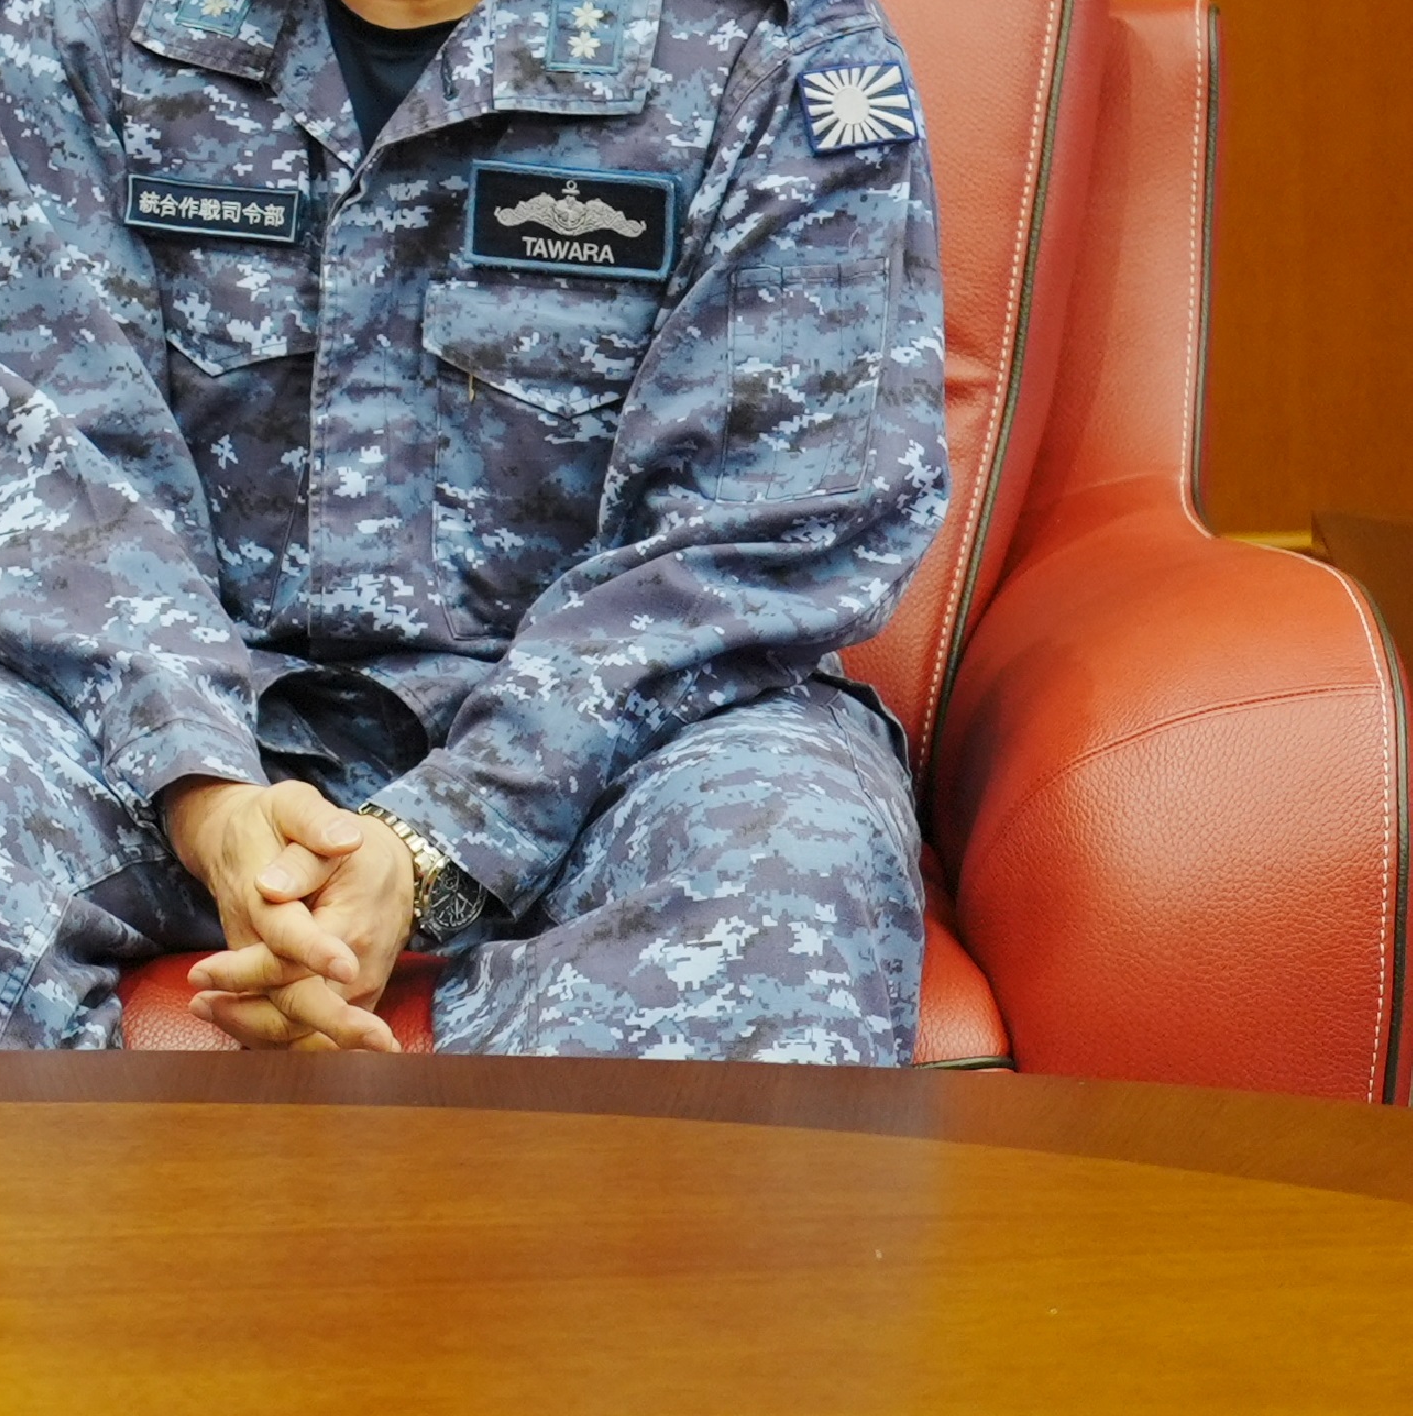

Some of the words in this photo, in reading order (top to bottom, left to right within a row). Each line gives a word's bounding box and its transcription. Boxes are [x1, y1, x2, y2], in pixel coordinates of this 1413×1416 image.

[139, 191, 285, 227] 統合作戦司令部
[522, 236, 615, 264] TAWARA
